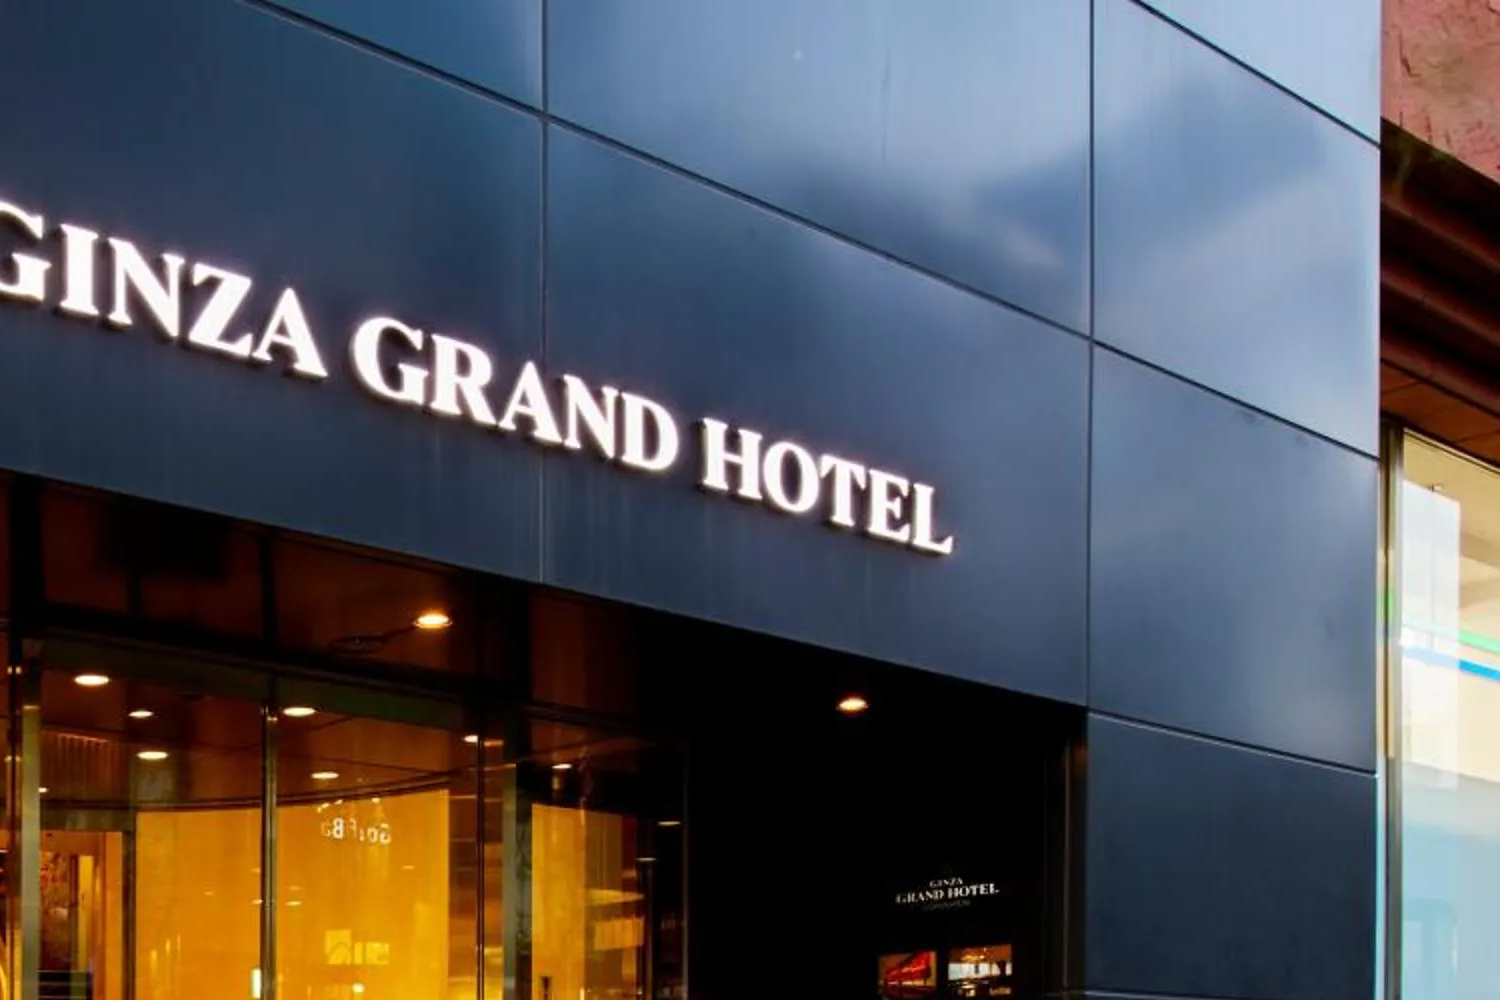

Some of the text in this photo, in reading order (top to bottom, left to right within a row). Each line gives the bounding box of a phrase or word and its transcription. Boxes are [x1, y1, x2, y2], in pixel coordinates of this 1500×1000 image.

[352, 316, 680, 472] GRAND
[702, 416, 954, 555] HOTEL
[946, 883, 1000, 899] HOTEL
